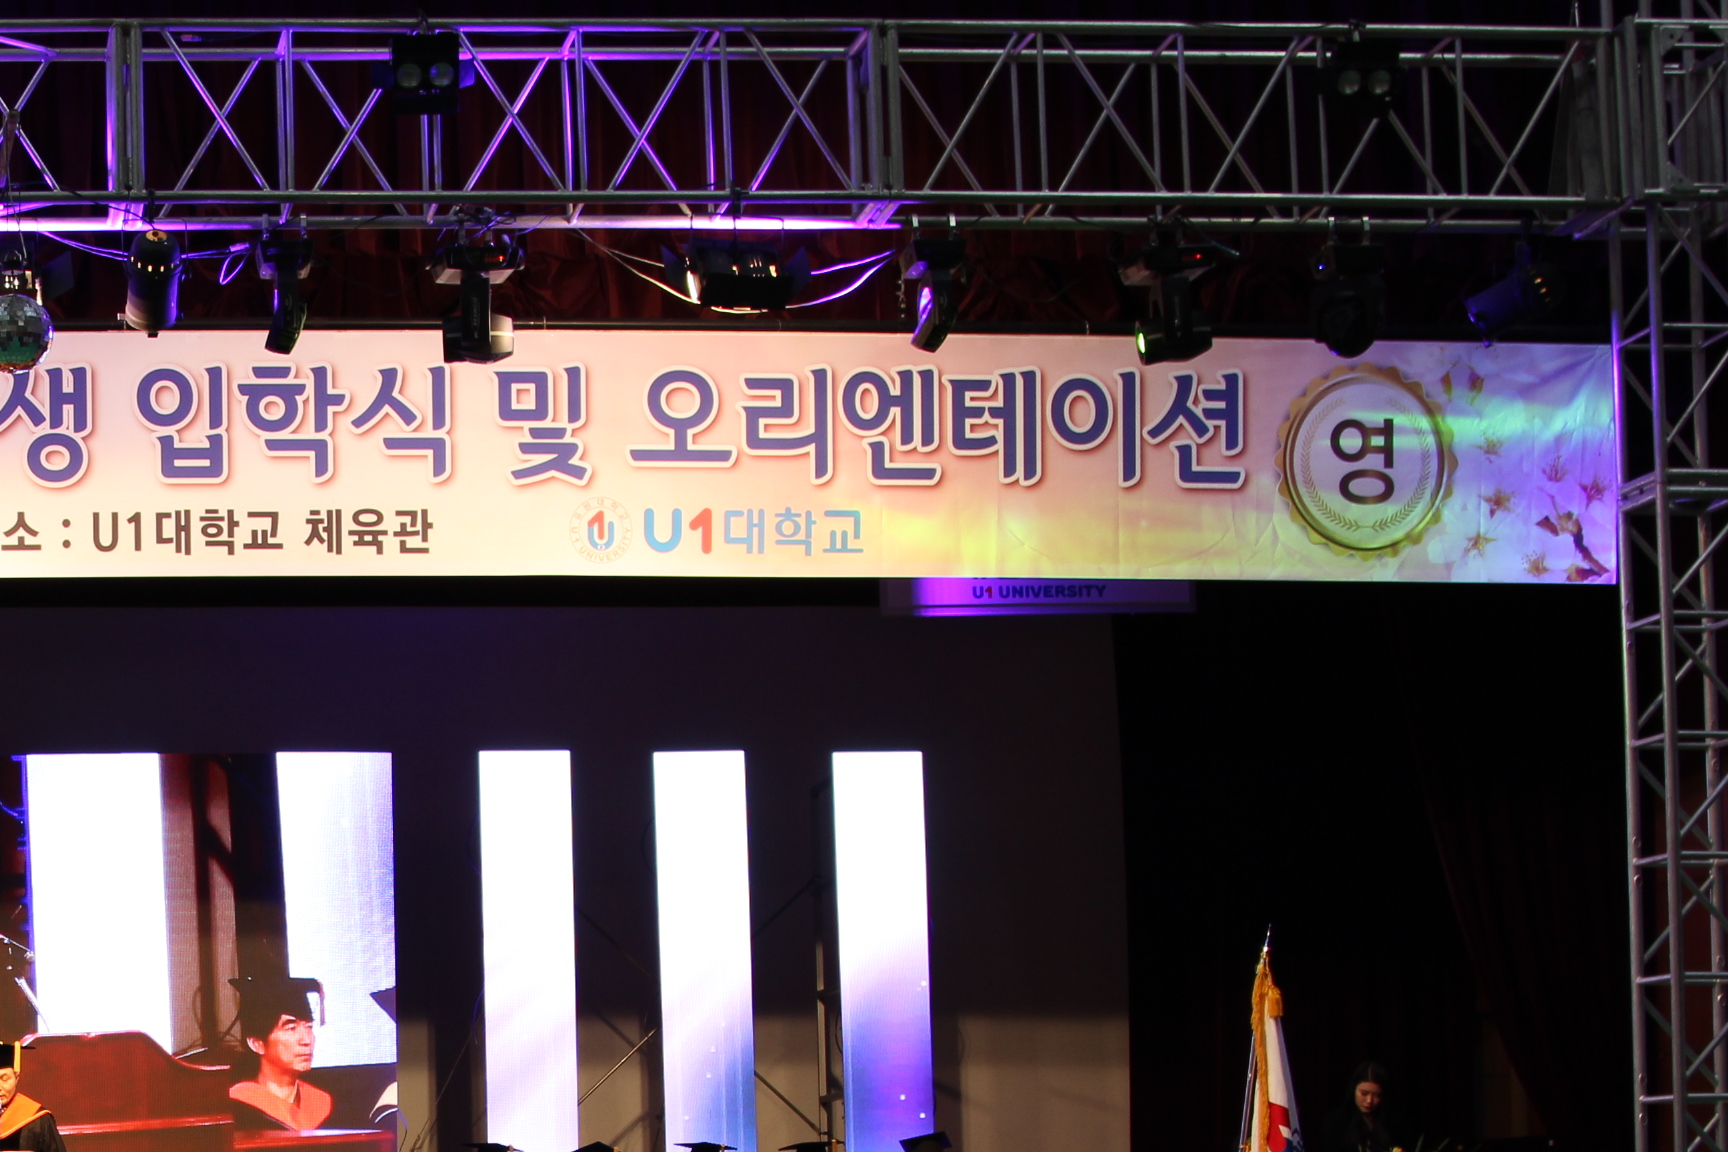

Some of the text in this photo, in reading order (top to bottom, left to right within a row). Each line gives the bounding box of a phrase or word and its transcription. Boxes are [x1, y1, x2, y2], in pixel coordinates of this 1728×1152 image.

[136, 364, 454, 483] 입학식
[494, 364, 590, 484] 및
[628, 365, 1248, 490] 오리엔테이션
[1330, 416, 1396, 507] 영
[92, 508, 284, 556] U1대학교
[304, 508, 433, 556] 체육관
[644, 507, 864, 556] U1대학교
[972, 584, 1107, 599] U1 UNIVERSITY
